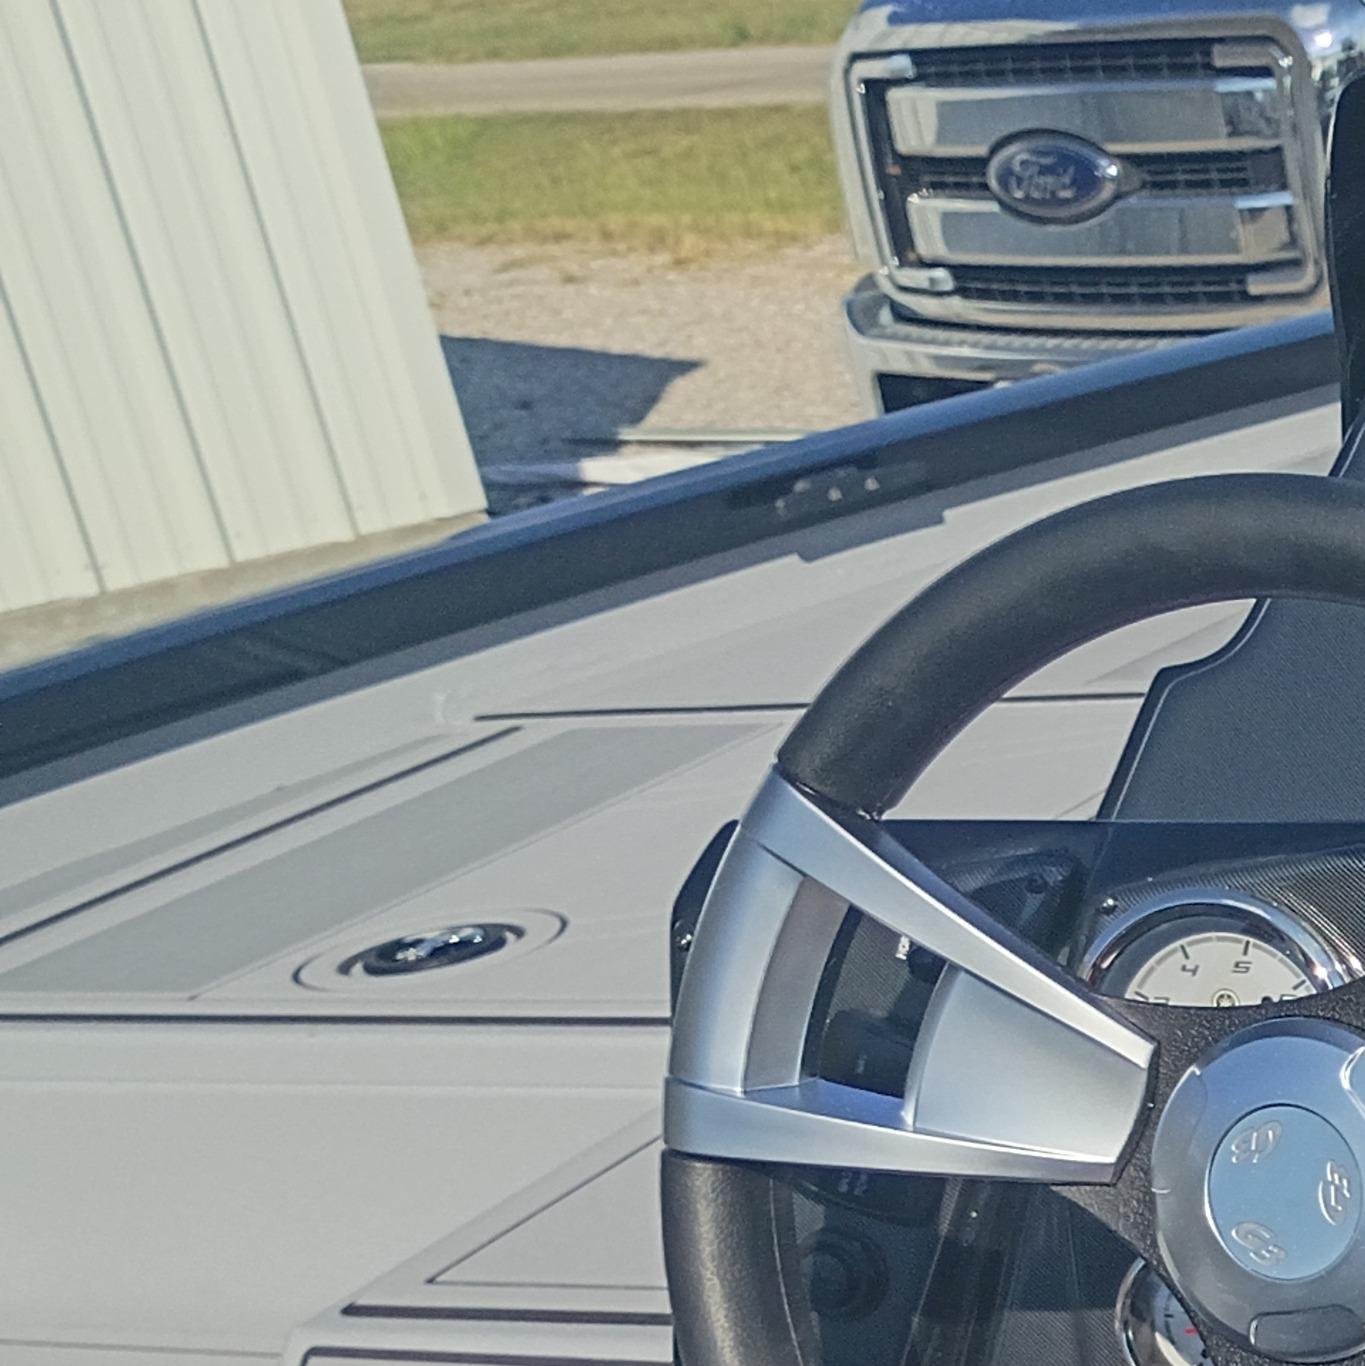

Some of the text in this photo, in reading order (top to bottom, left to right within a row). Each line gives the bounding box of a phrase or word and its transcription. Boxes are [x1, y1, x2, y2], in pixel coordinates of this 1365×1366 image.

[1009, 151, 1076, 199] Ford
[1180, 963, 1200, 977] 4
[1230, 960, 1253, 974] 5
